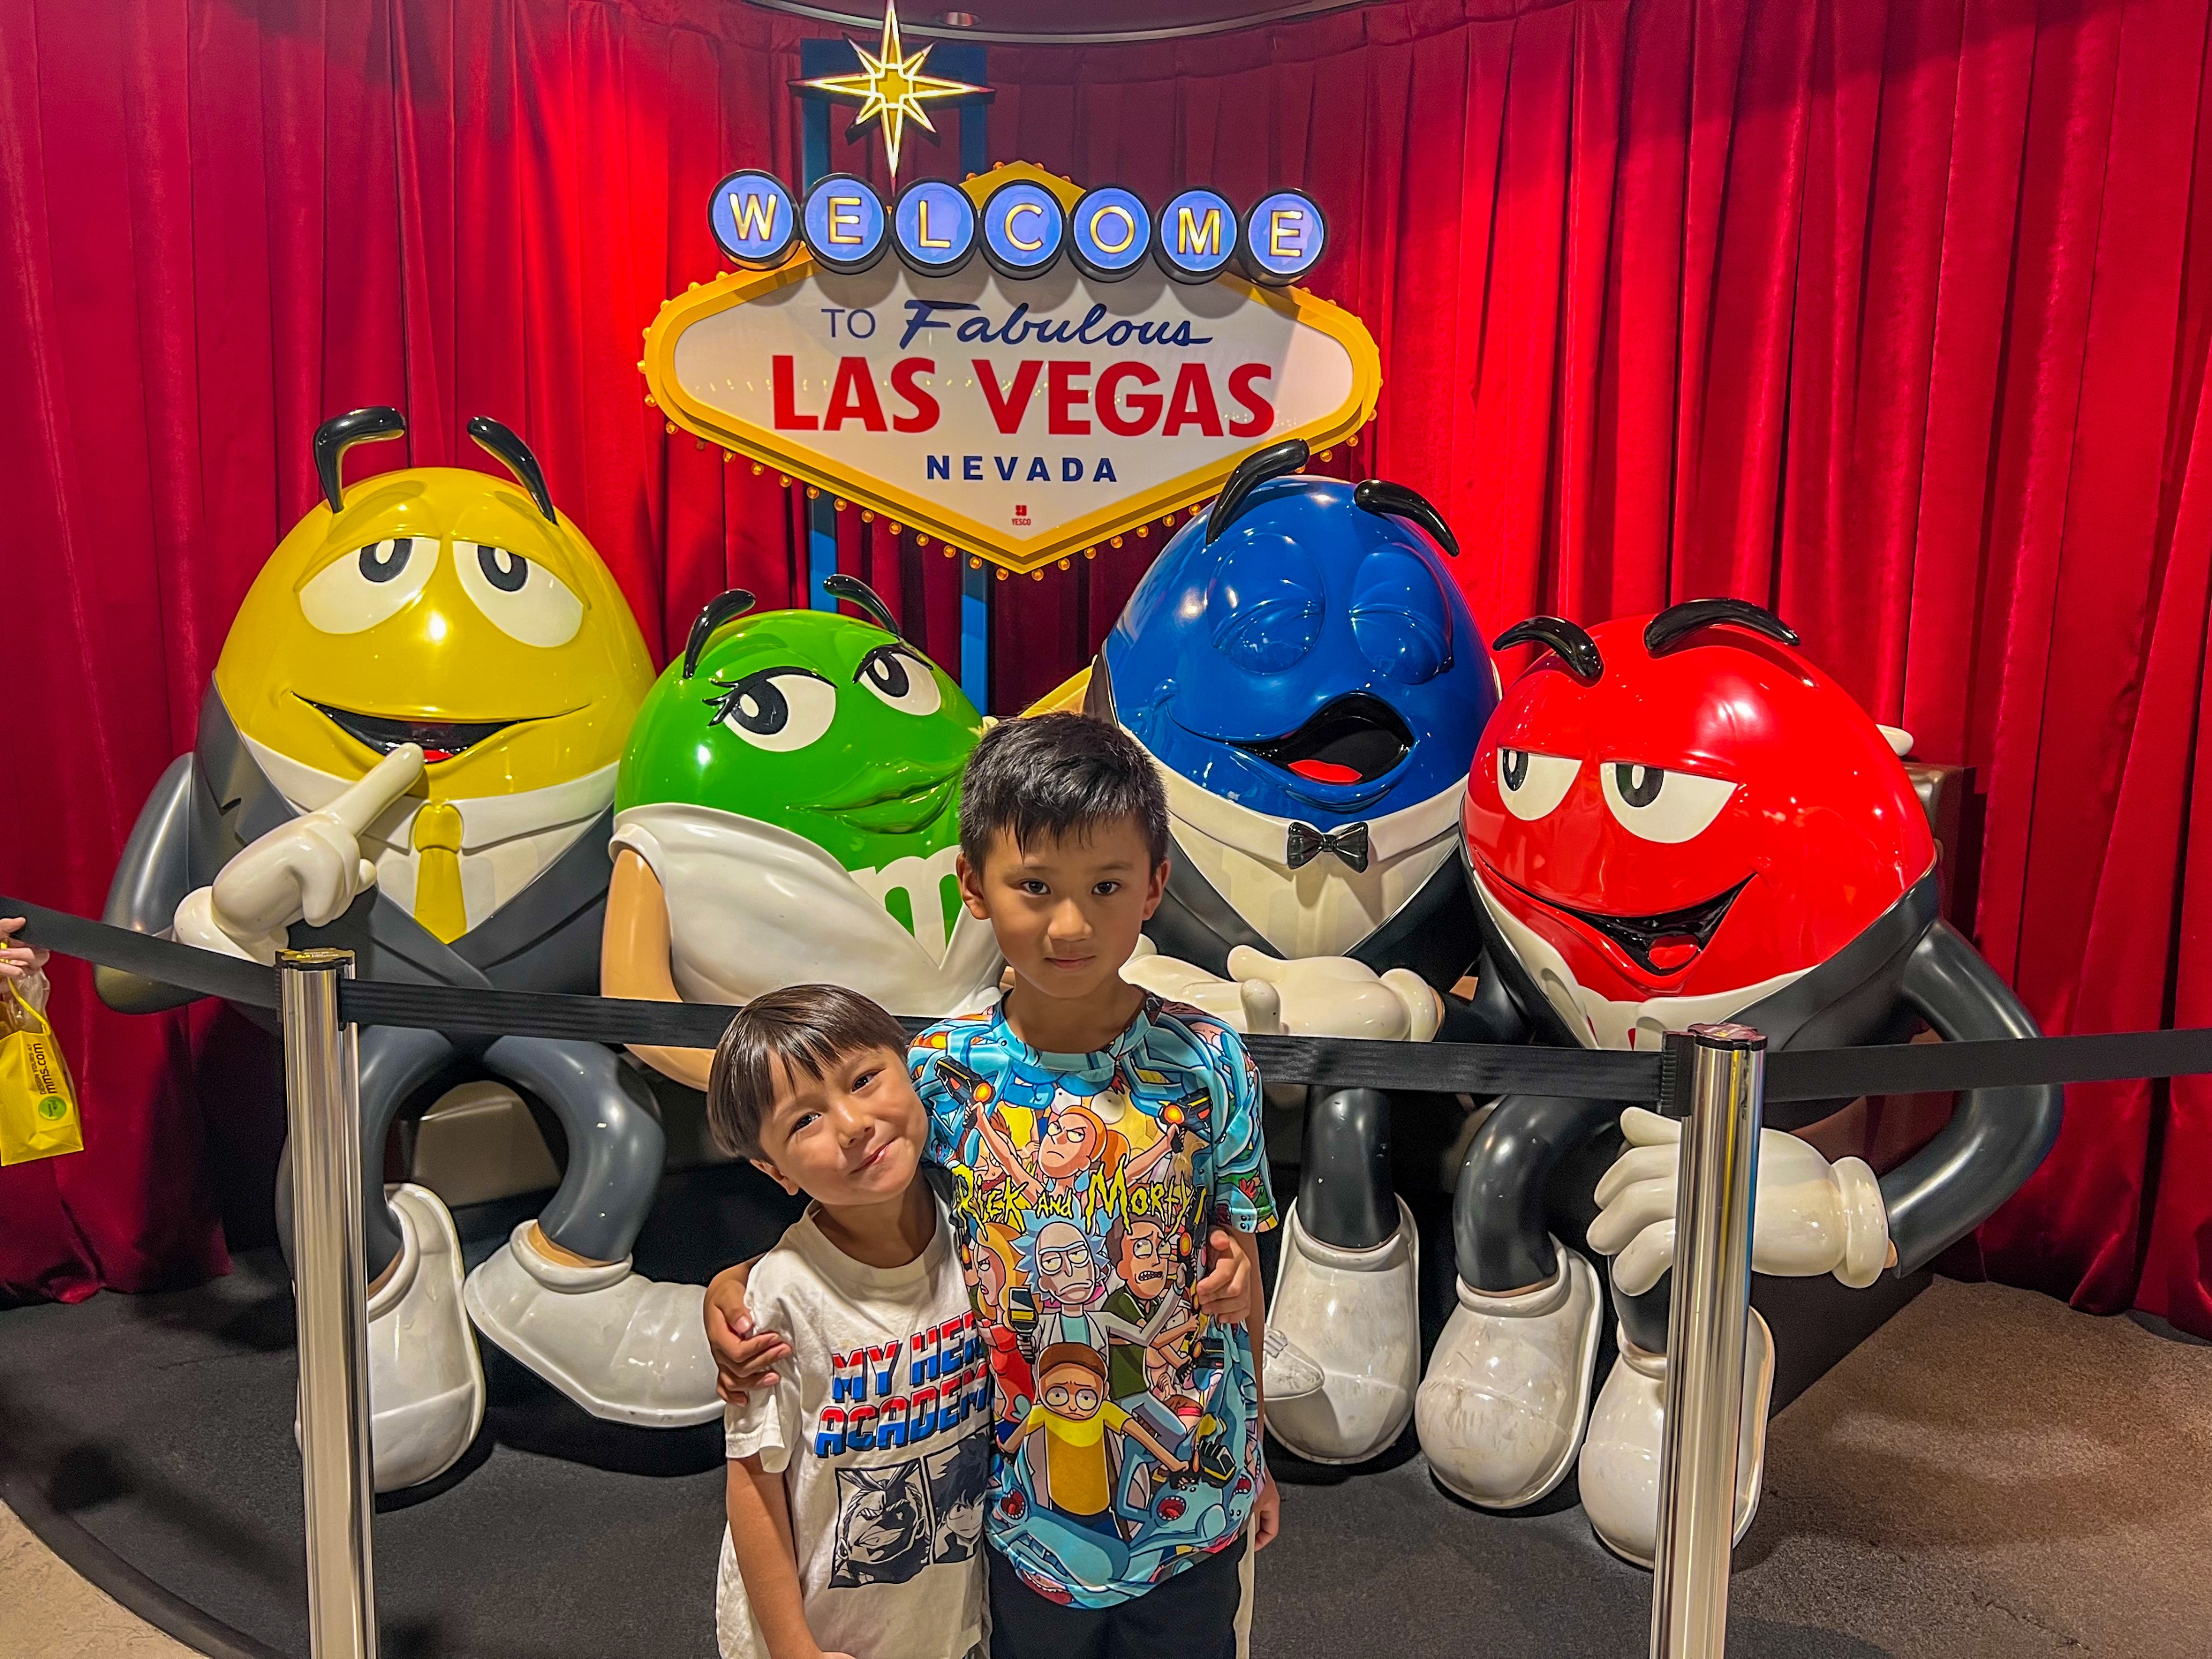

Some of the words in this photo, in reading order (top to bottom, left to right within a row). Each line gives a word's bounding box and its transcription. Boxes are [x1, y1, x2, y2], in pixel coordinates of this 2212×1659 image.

[729, 192, 1303, 258] WELCOME
[822, 308, 876, 339] TO
[899, 299, 1213, 348] Fabulous
[773, 356, 940, 433] LAS
[973, 360, 1273, 437] VEGAS
[928, 455, 1117, 482] NEVADA
[33, 1043, 57, 1094] mms.com
[831, 1341, 902, 1404] MY
[814, 1361, 992, 1458] ACADEM
